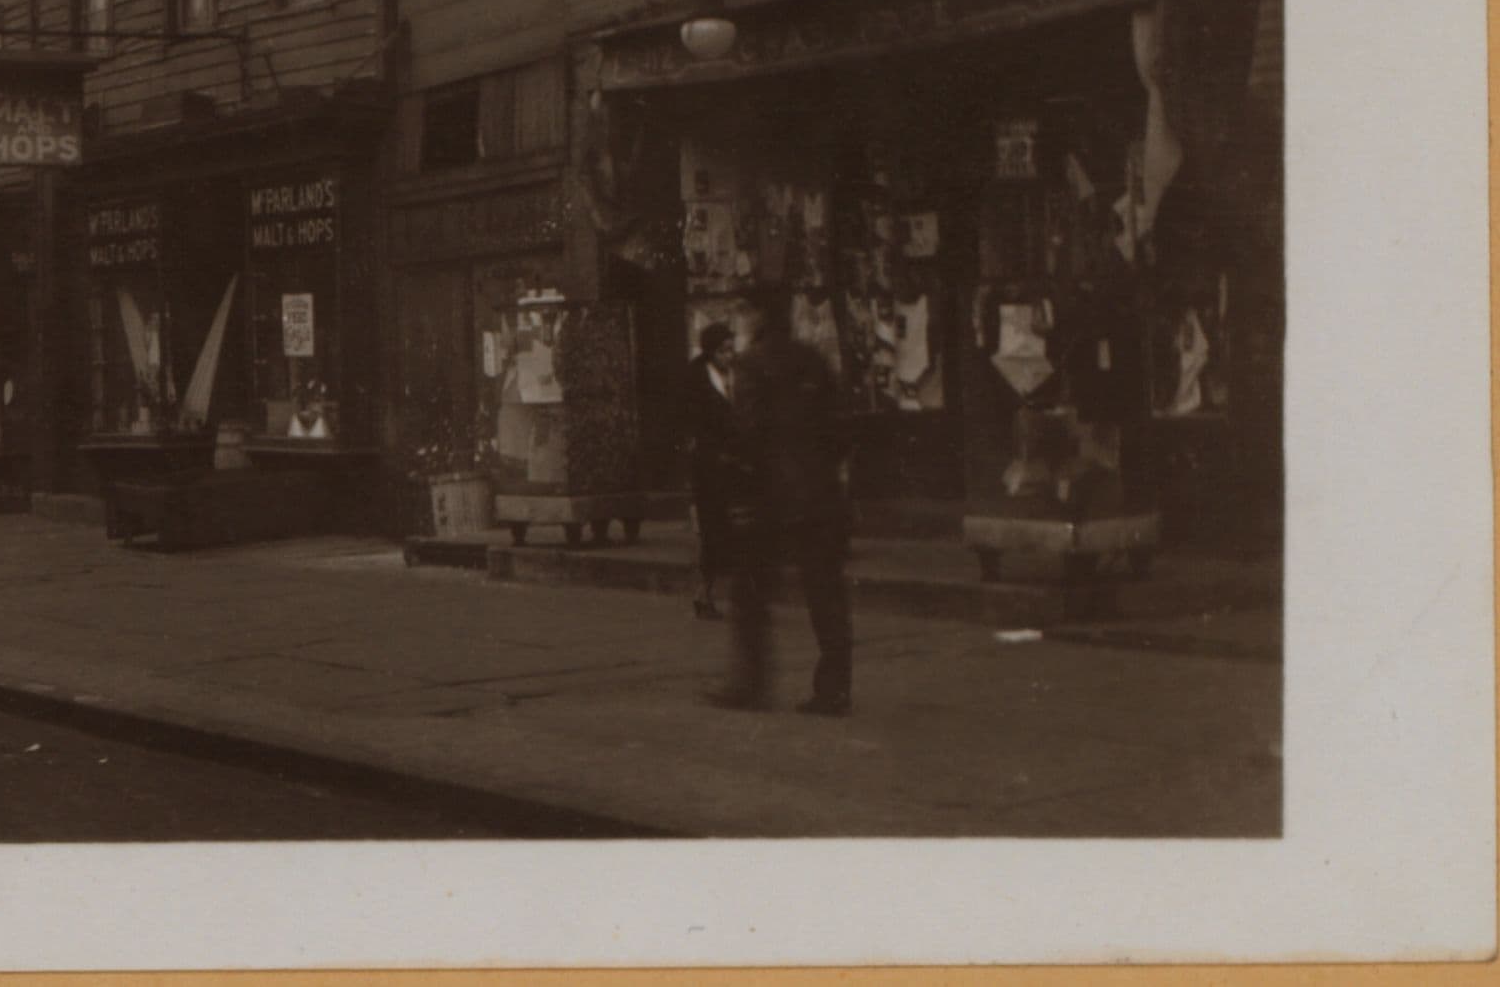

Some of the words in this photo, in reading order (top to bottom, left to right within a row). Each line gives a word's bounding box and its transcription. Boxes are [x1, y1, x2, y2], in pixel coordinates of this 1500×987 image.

[252, 221, 284, 248] MALT
[297, 217, 335, 245] HOPS
[90, 243, 117, 266] MALT
[127, 237, 158, 261] HOPS
